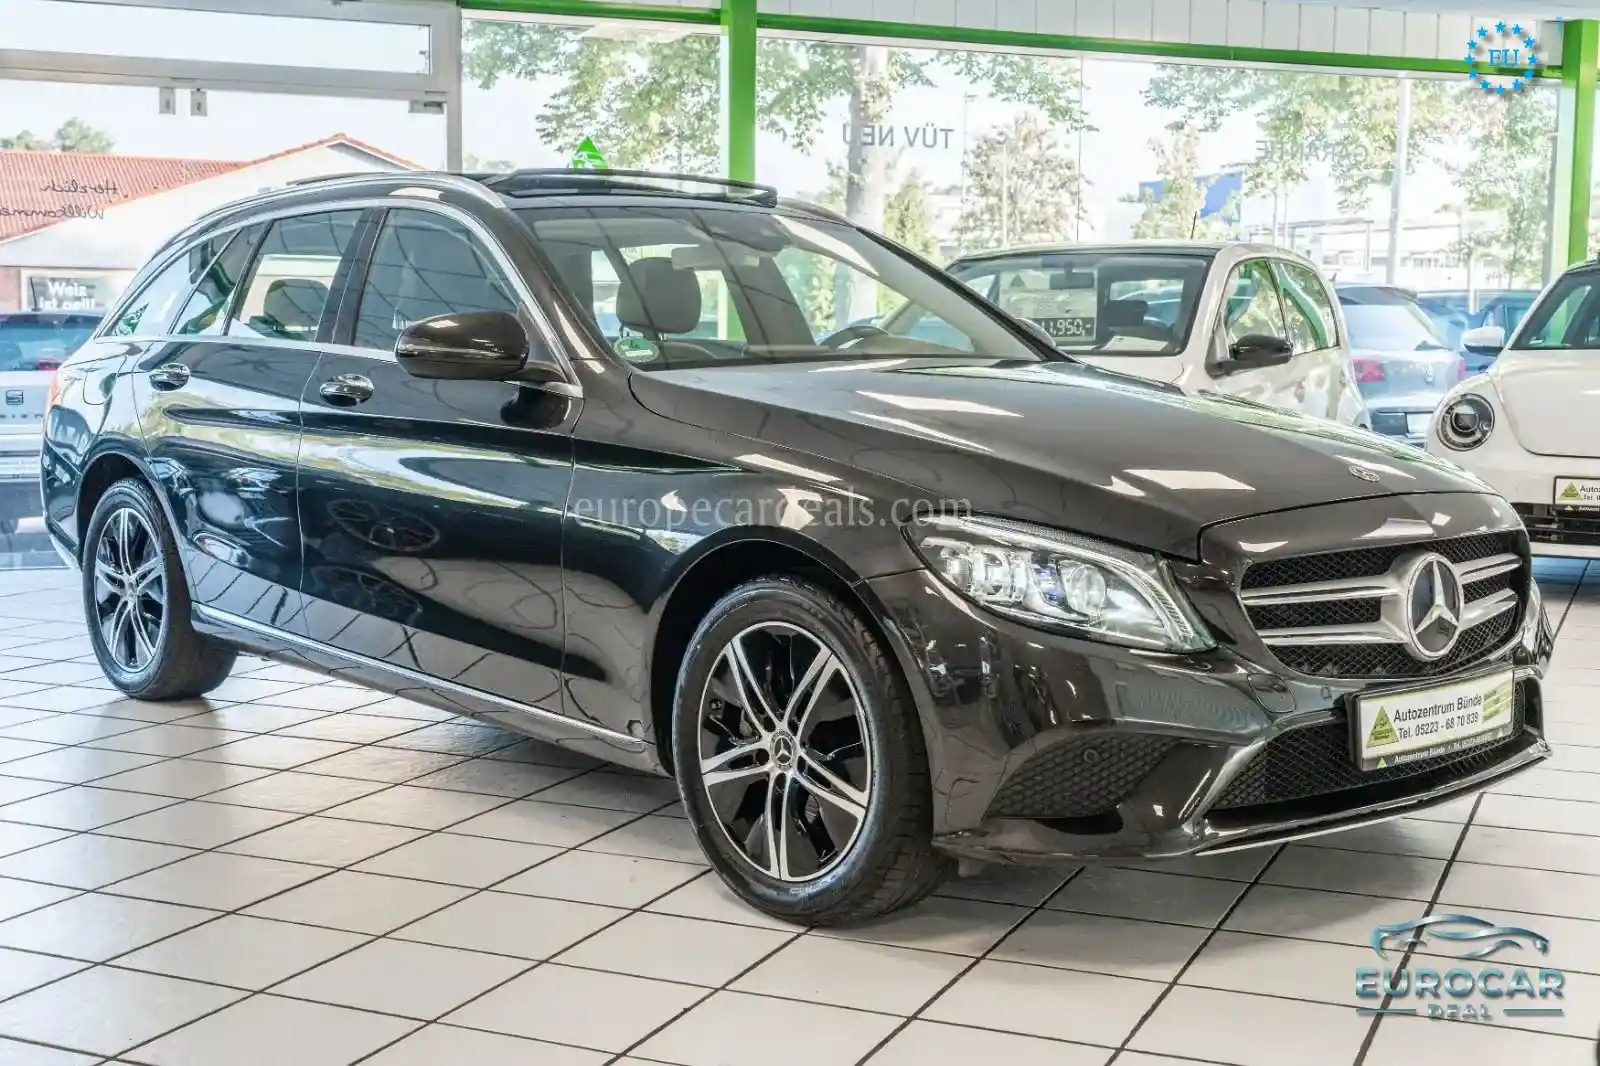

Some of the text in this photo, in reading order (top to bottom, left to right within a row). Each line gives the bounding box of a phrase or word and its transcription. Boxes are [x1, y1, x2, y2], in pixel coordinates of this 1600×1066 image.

[1393, 702, 1455, 723] Autozentrum
[1456, 693, 1482, 711] Bünde
[1397, 726, 1413, 740] Tel.
[1415, 721, 1439, 736] 05223
[1445, 716, 1455, 730] 68
[1456, 714, 1465, 728] 70
